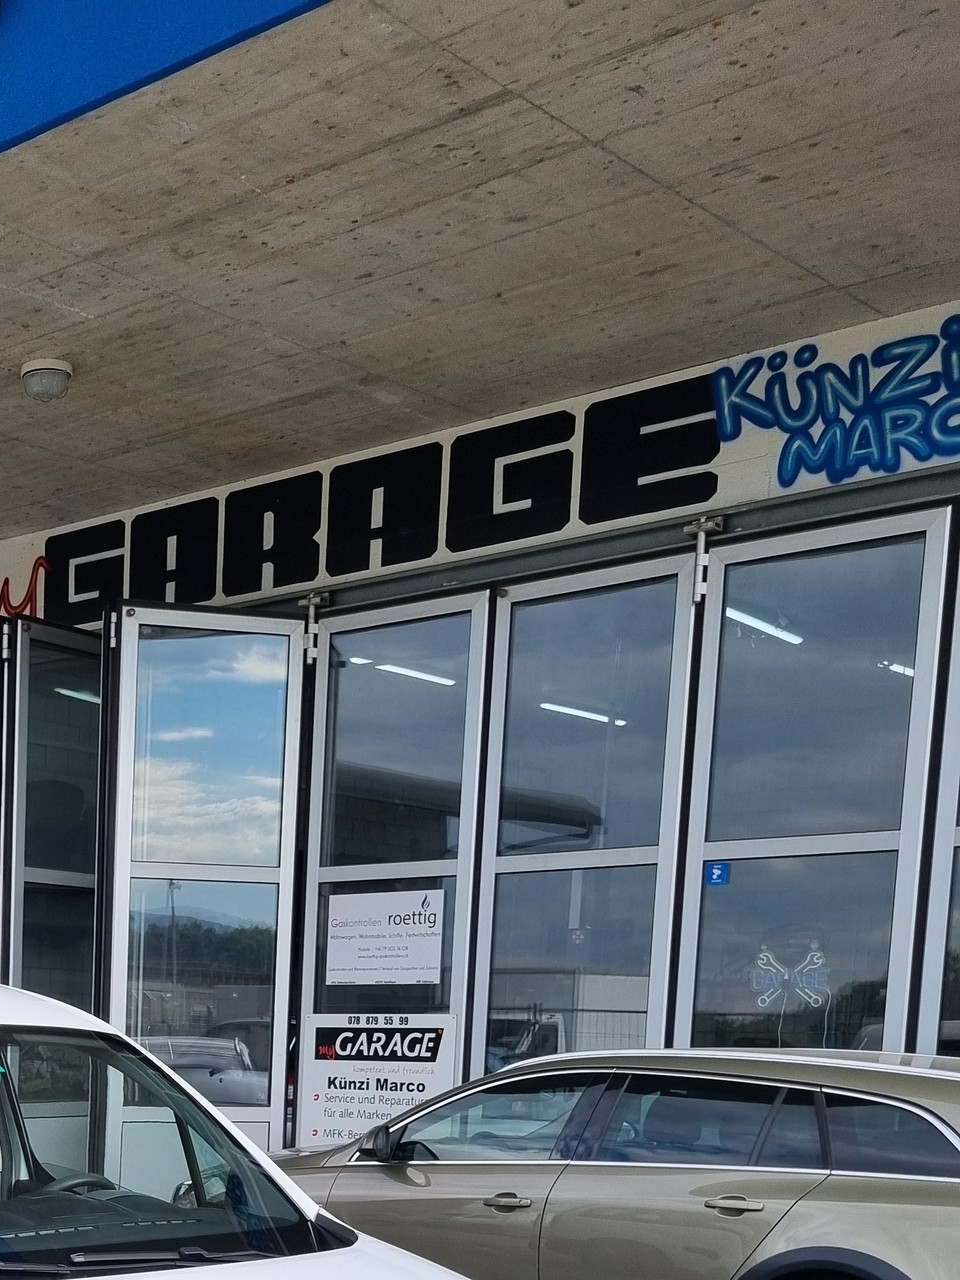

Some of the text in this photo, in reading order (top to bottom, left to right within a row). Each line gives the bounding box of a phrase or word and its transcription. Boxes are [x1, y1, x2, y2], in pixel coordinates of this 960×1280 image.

[44, 371, 721, 628] GARAGE
[330, 910, 436, 928] Gaskontrollen roettig
[751, 968, 827, 991] GAAGE
[347, 1015, 361, 1025] 078
[383, 1016, 394, 1026] 55
[398, 1016, 409, 1026] 99
[319, 1031, 436, 1060] my GARAGE
[352, 1065, 436, 1077] kompetent und freundlich
[327, 1076, 427, 1093] Künzi Marco
[324, 1092, 356, 1104] Service
[358, 1094, 376, 1105] und
[323, 1106, 392, 1121] für alle Marken
